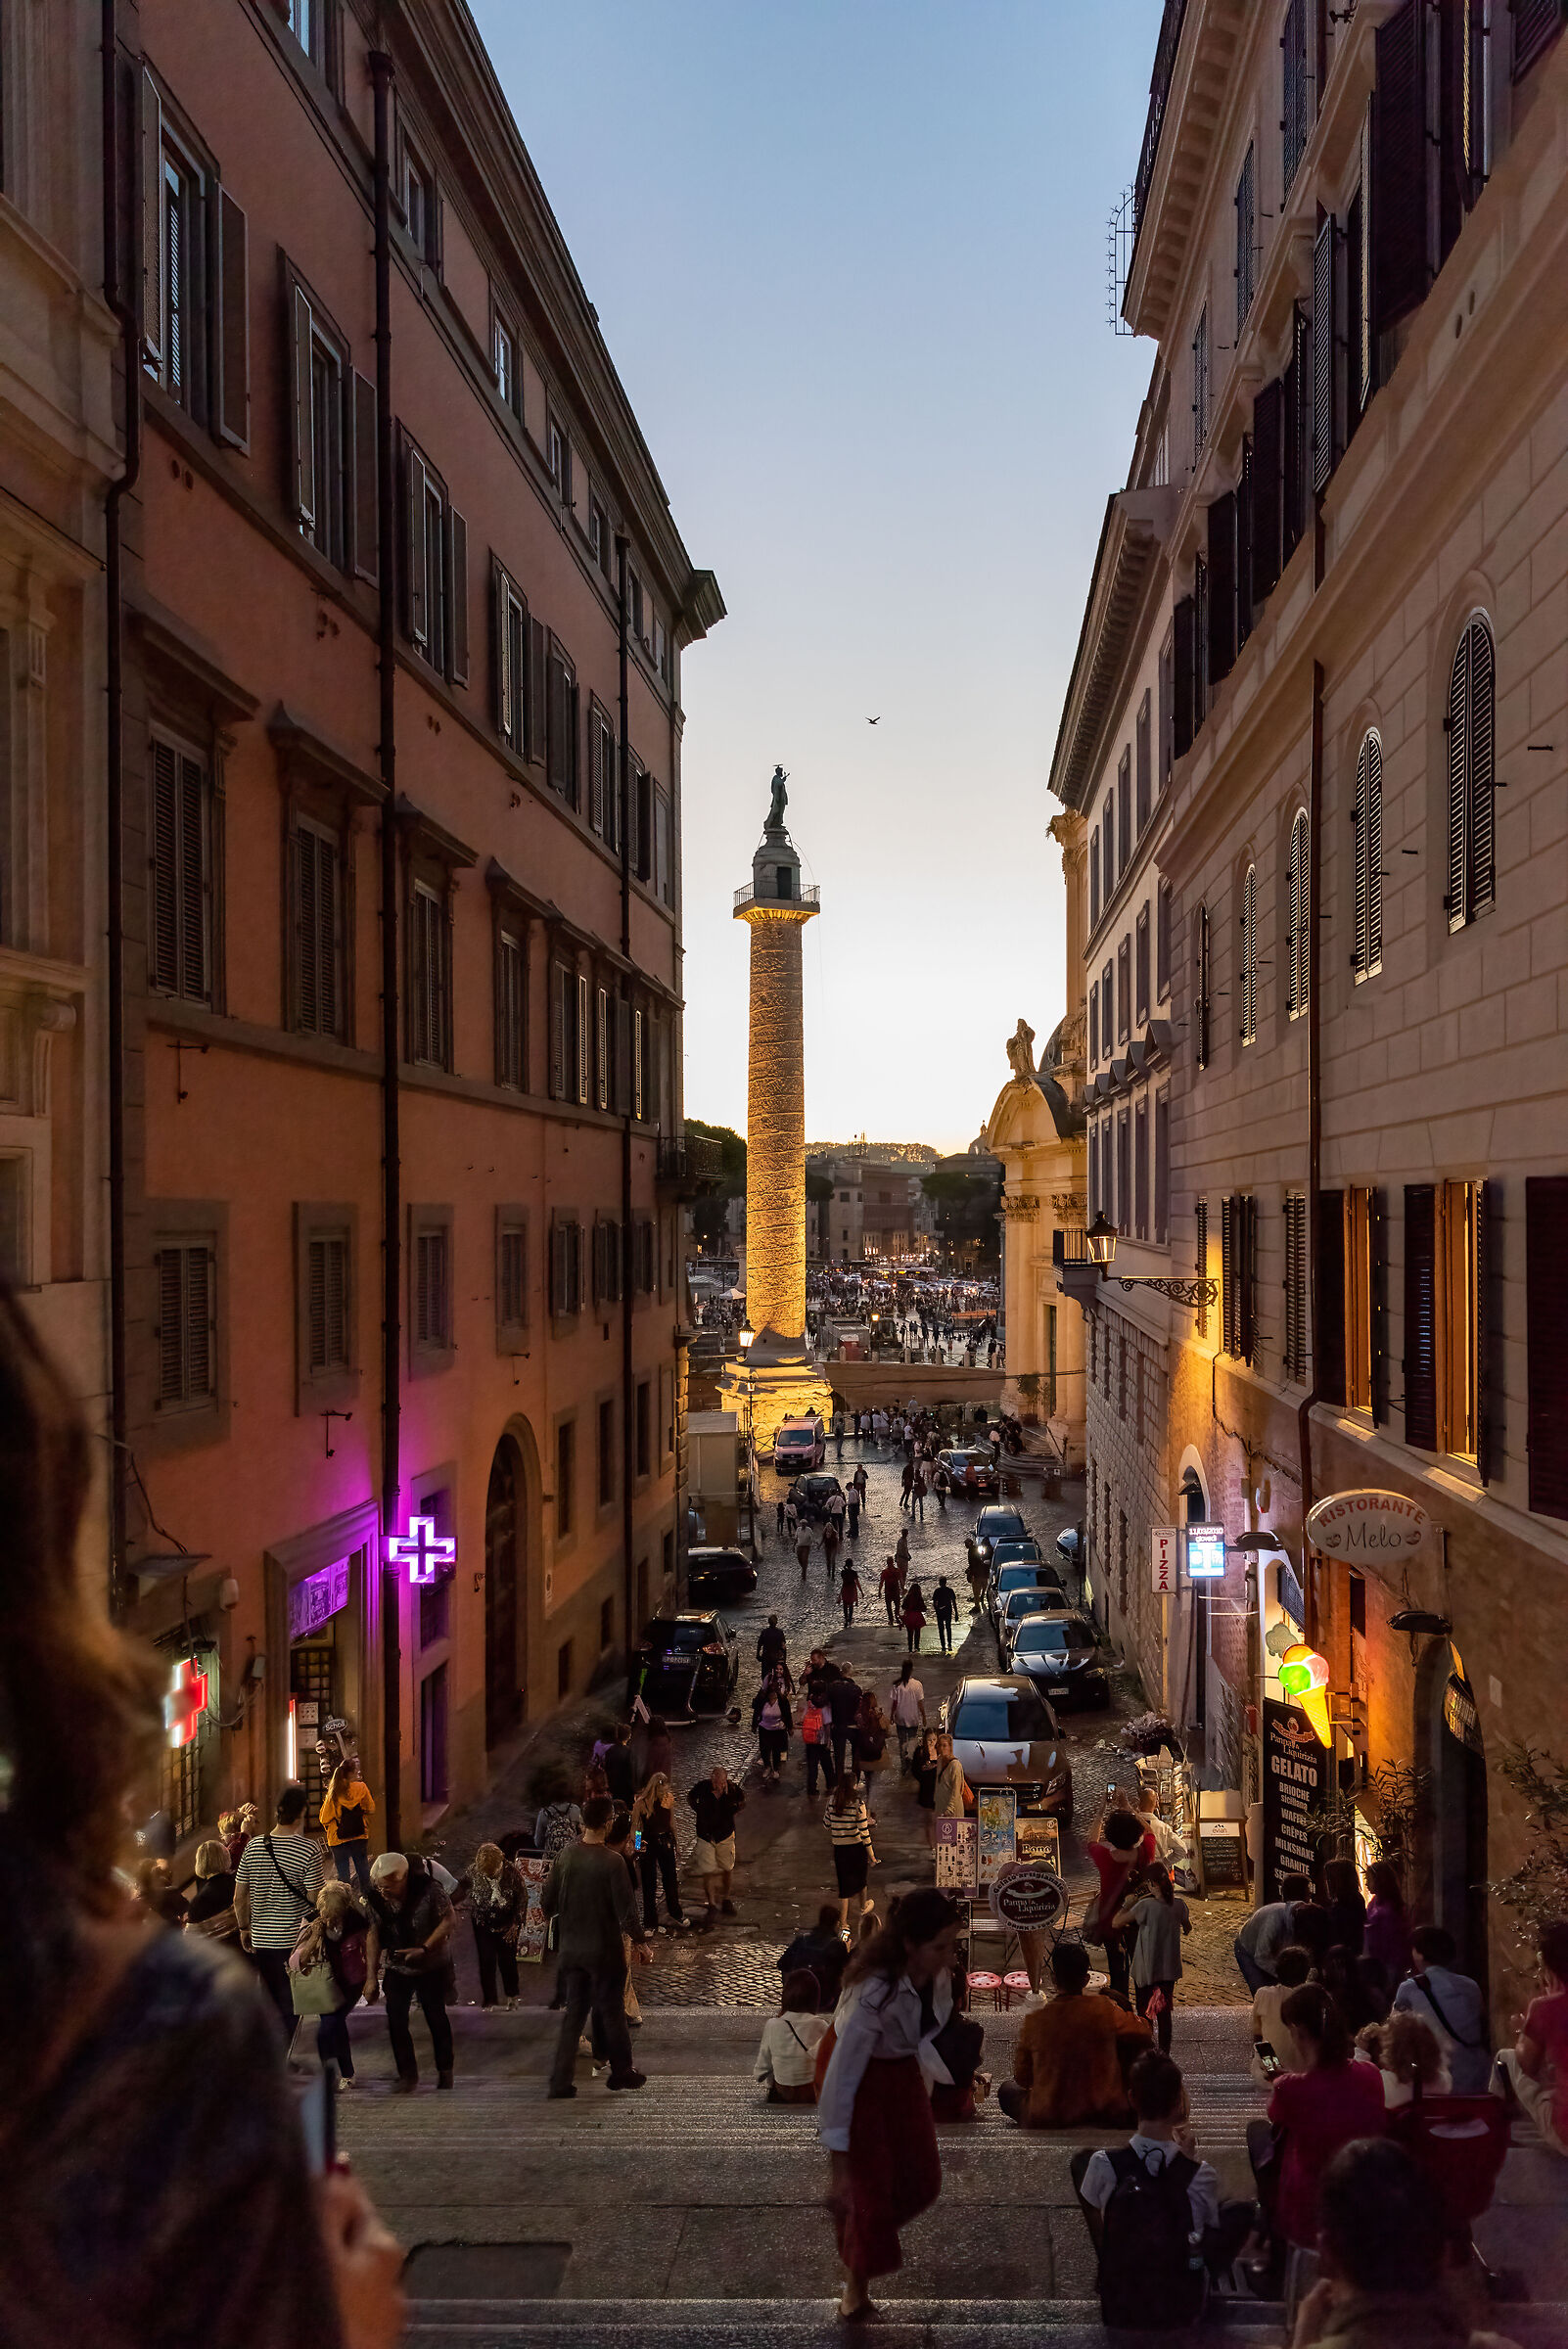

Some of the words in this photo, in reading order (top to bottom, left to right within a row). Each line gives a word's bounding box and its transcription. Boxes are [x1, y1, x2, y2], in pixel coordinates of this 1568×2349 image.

[1318, 1497, 1426, 1527] RISTORANTE
[1346, 1522, 1402, 1551] Melo
[1159, 1539, 1169, 1590] PIZZA
[1270, 1755, 1317, 1787] GELATO
[1279, 1781, 1310, 1801] BRIOCHE
[1274, 1837, 1314, 1862] MILKSHAKE
[1280, 1855, 1310, 1875] GRANITE
